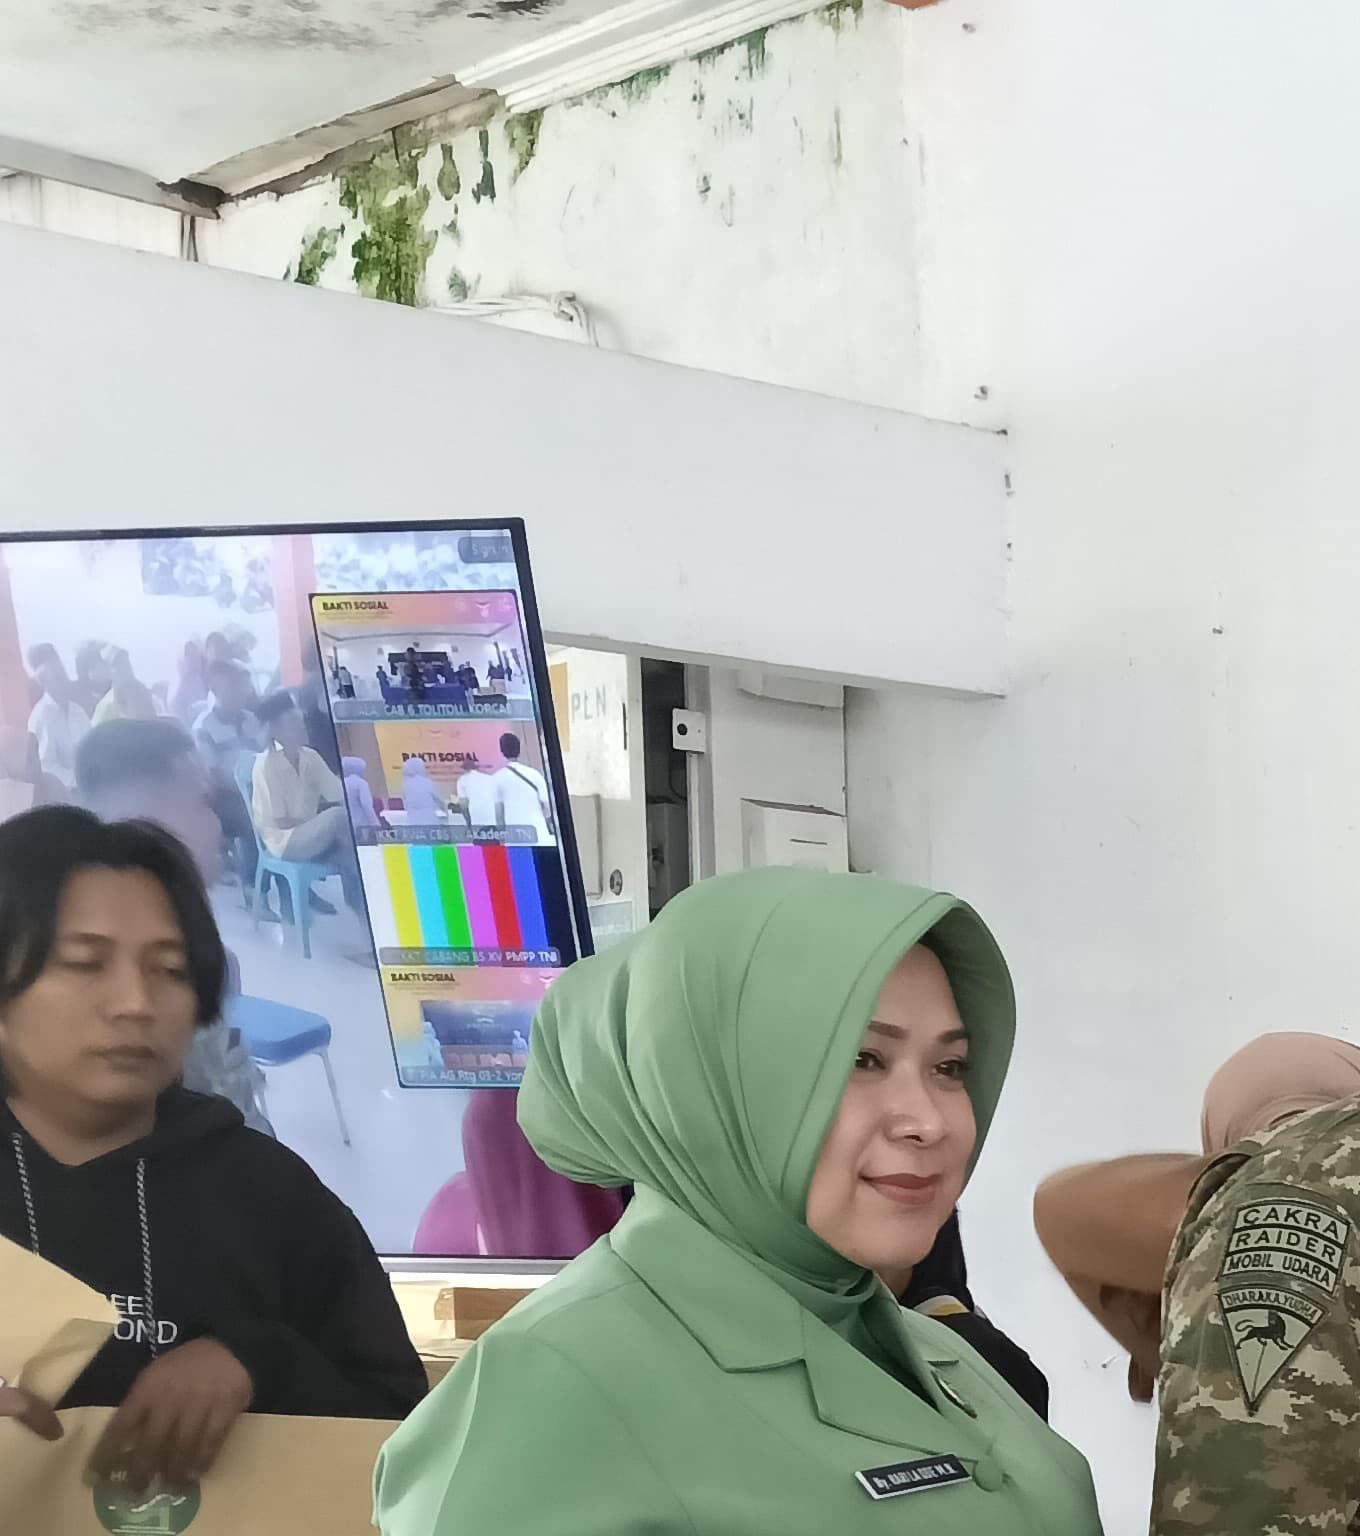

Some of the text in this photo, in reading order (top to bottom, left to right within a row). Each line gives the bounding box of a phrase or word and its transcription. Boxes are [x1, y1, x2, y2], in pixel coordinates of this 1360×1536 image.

[322, 601, 352, 610] BAKTI
[571, 684, 607, 721] PLN
[439, 752, 479, 762] SOSIAL
[1243, 1206, 1339, 1240] CAKRA
[1234, 1230, 1336, 1262] RAIDER
[1227, 1253, 1330, 1287] MOBIL UDARA
[110, 1293, 145, 1316] EE
[113, 1317, 178, 1345] OND
